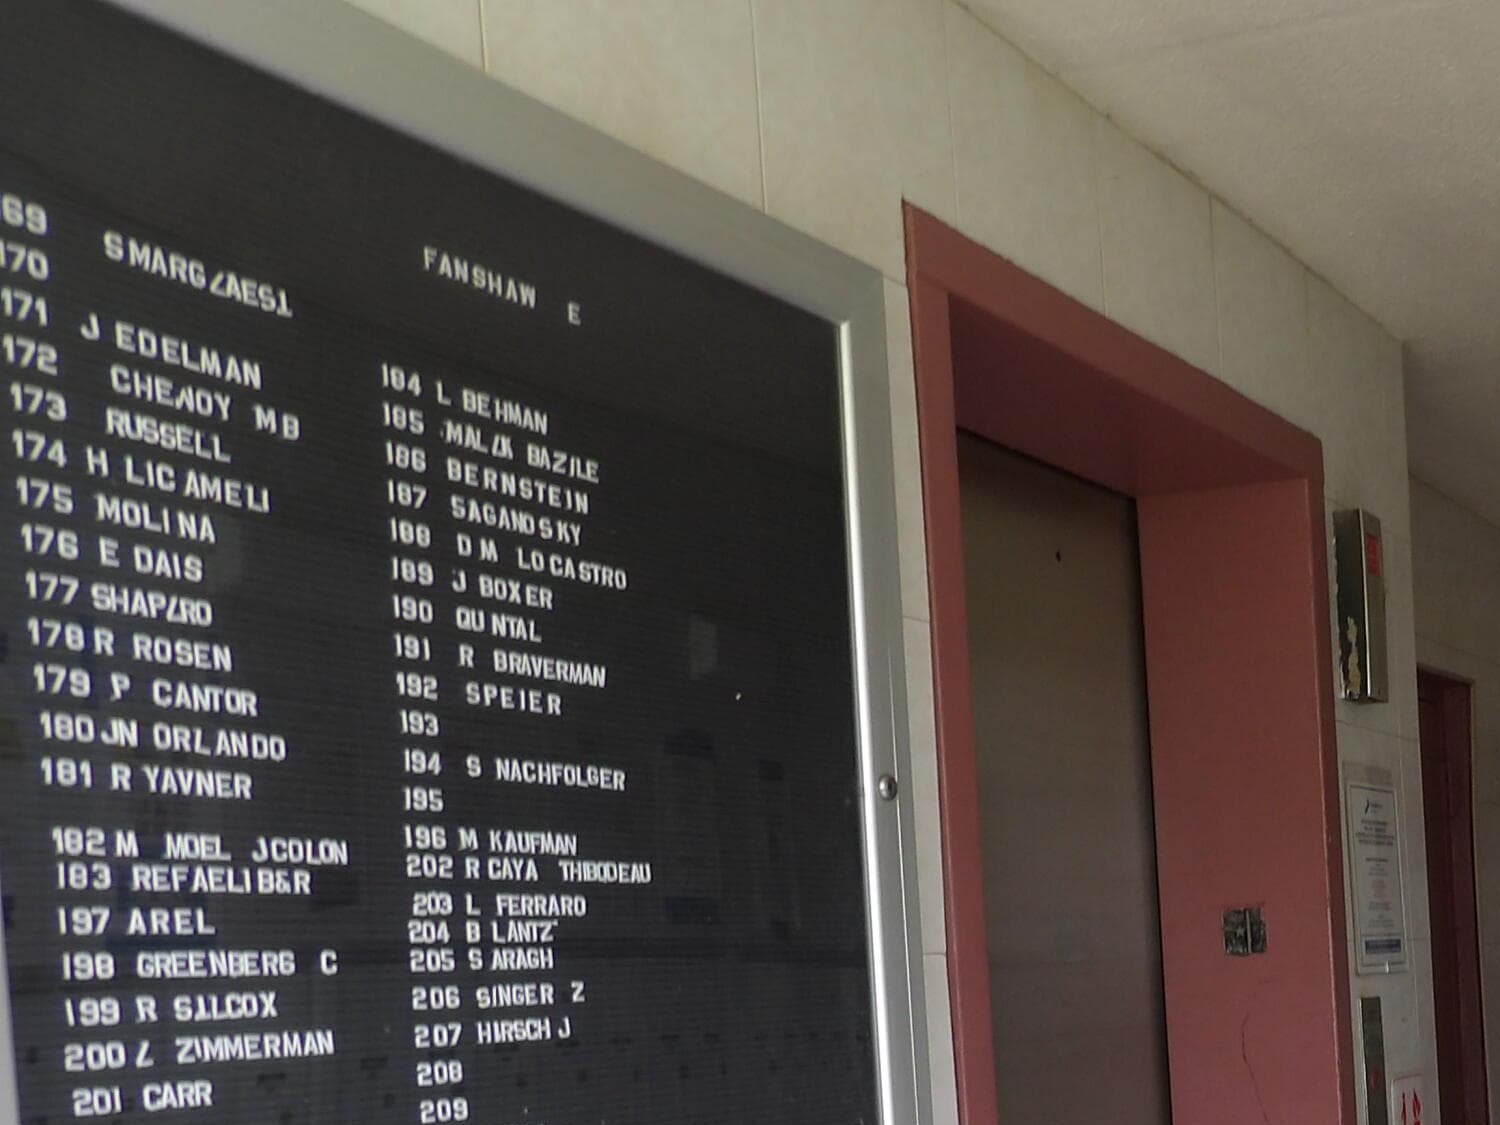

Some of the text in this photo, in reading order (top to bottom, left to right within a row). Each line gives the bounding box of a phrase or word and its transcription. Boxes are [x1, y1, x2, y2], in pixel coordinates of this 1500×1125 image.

[0, 194, 47, 235] 69
[423, 245, 581, 326] FANSHAW E
[1, 287, 262, 390] 171 J EDELMAN
[2, 333, 58, 376] 172
[381, 362, 422, 397] 184
[436, 380, 451, 405] L
[10, 381, 232, 464] 173 RUSSELL
[382, 402, 424, 435] 185
[12, 429, 67, 468] 174
[86, 445, 109, 477] H
[386, 441, 589, 515] 186 BERNSTEIN
[387, 479, 426, 510] 187
[16, 475, 216, 545] 175 MOLINA
[391, 517, 431, 548] 188
[21, 523, 203, 583] 176 E DAIS
[25, 569, 80, 606] 177
[391, 556, 553, 611] 189 J BOXER
[392, 595, 434, 624] 190
[27, 616, 232, 672] 178 R ROSEN
[393, 633, 606, 689] 191 R BRAVERMAN
[33, 662, 258, 718] 179 P CANTOR
[396, 671, 562, 716] 192 SPEIER
[40, 710, 95, 743] 180
[152, 721, 287, 763] ORLANDO
[400, 709, 440, 737] 193
[40, 756, 253, 800] 181 R YAVNER
[404, 748, 626, 792] 194 S NACHFOLGER
[403, 787, 444, 813] 195
[51, 826, 106, 856] 182
[115, 829, 139, 858] M
[404, 824, 577, 857] 196 M KAUFMAN
[57, 861, 112, 890] 183
[406, 853, 454, 879] 202
[464, 856, 480, 880] R
[488, 857, 539, 882] CAYA
[58, 906, 216, 936] 197 AREL
[412, 891, 587, 917] 203 L FERRARO
[407, 919, 451, 944] 204
[466, 920, 481, 944] B
[61, 949, 338, 981] 198 GREENBERG C
[410, 947, 554, 973] 205 S ARAGH
[64, 996, 121, 1027] 199
[135, 995, 158, 1023] R
[412, 980, 586, 1011] 206 SINGER Z
[64, 1041, 126, 1072] 200
[175, 1029, 335, 1065] ZIMMERMAN
[414, 1016, 571, 1049] 207 HIRSCH J
[416, 1059, 464, 1087] 208
[72, 1079, 213, 1118] 201 CARR
[419, 1097, 469, 1125] 209
